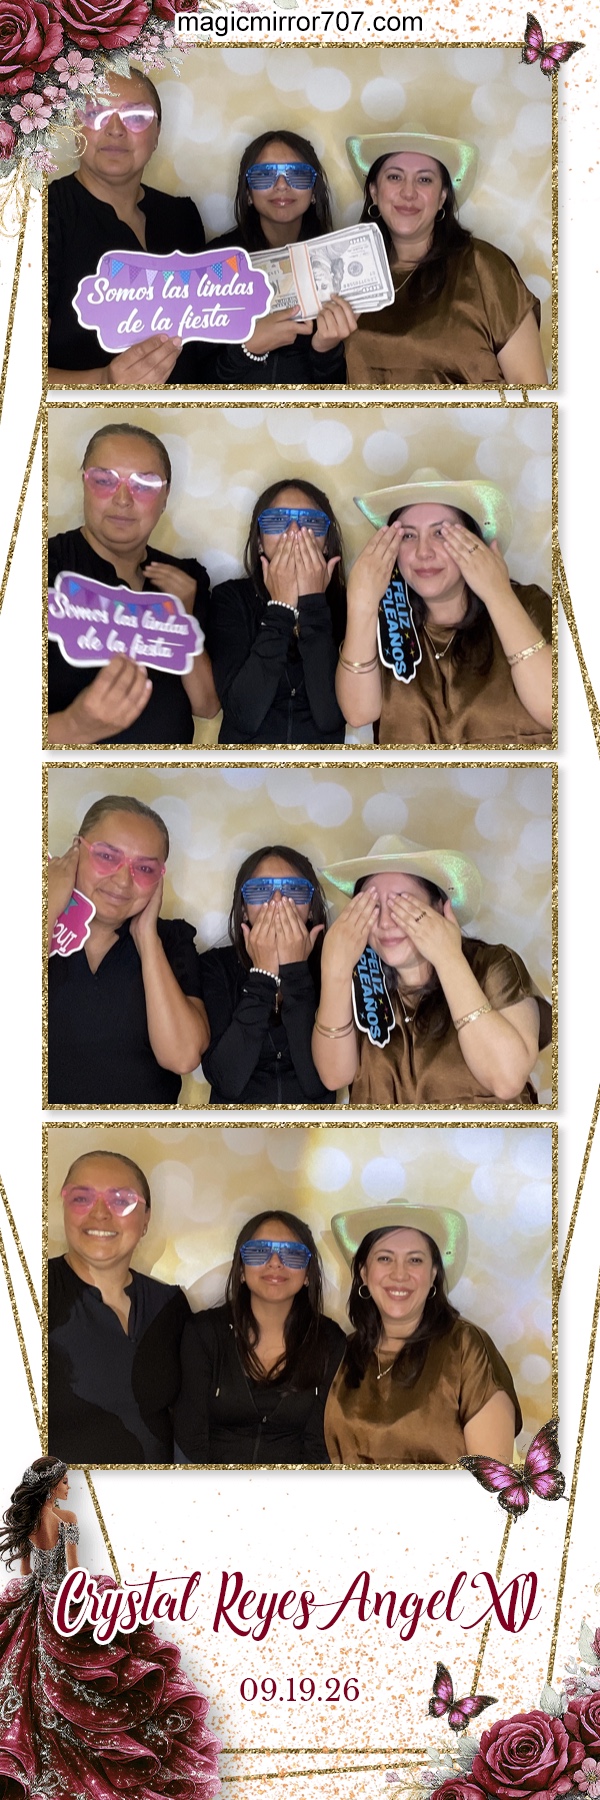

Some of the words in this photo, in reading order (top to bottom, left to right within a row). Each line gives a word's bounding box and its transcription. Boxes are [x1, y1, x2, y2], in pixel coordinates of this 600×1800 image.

[87, 277, 154, 305] Somos
[162, 274, 189, 299] las
[196, 272, 254, 297] lindas
[117, 308, 145, 334] de
[151, 306, 173, 331] la
[177, 303, 246, 337] fiesta
[49, 591, 109, 624] Somos
[113, 604, 139, 628] las
[141, 610, 190, 635] lindas
[392, 581, 411, 630] FELIZ
[77, 625, 104, 651] de
[106, 629, 129, 653] la
[129, 632, 185, 660] fiesta
[383, 586, 407, 675] PLEAÑOS
[52, 919, 78, 954] Inc
[365, 947, 385, 995] FELIZ
